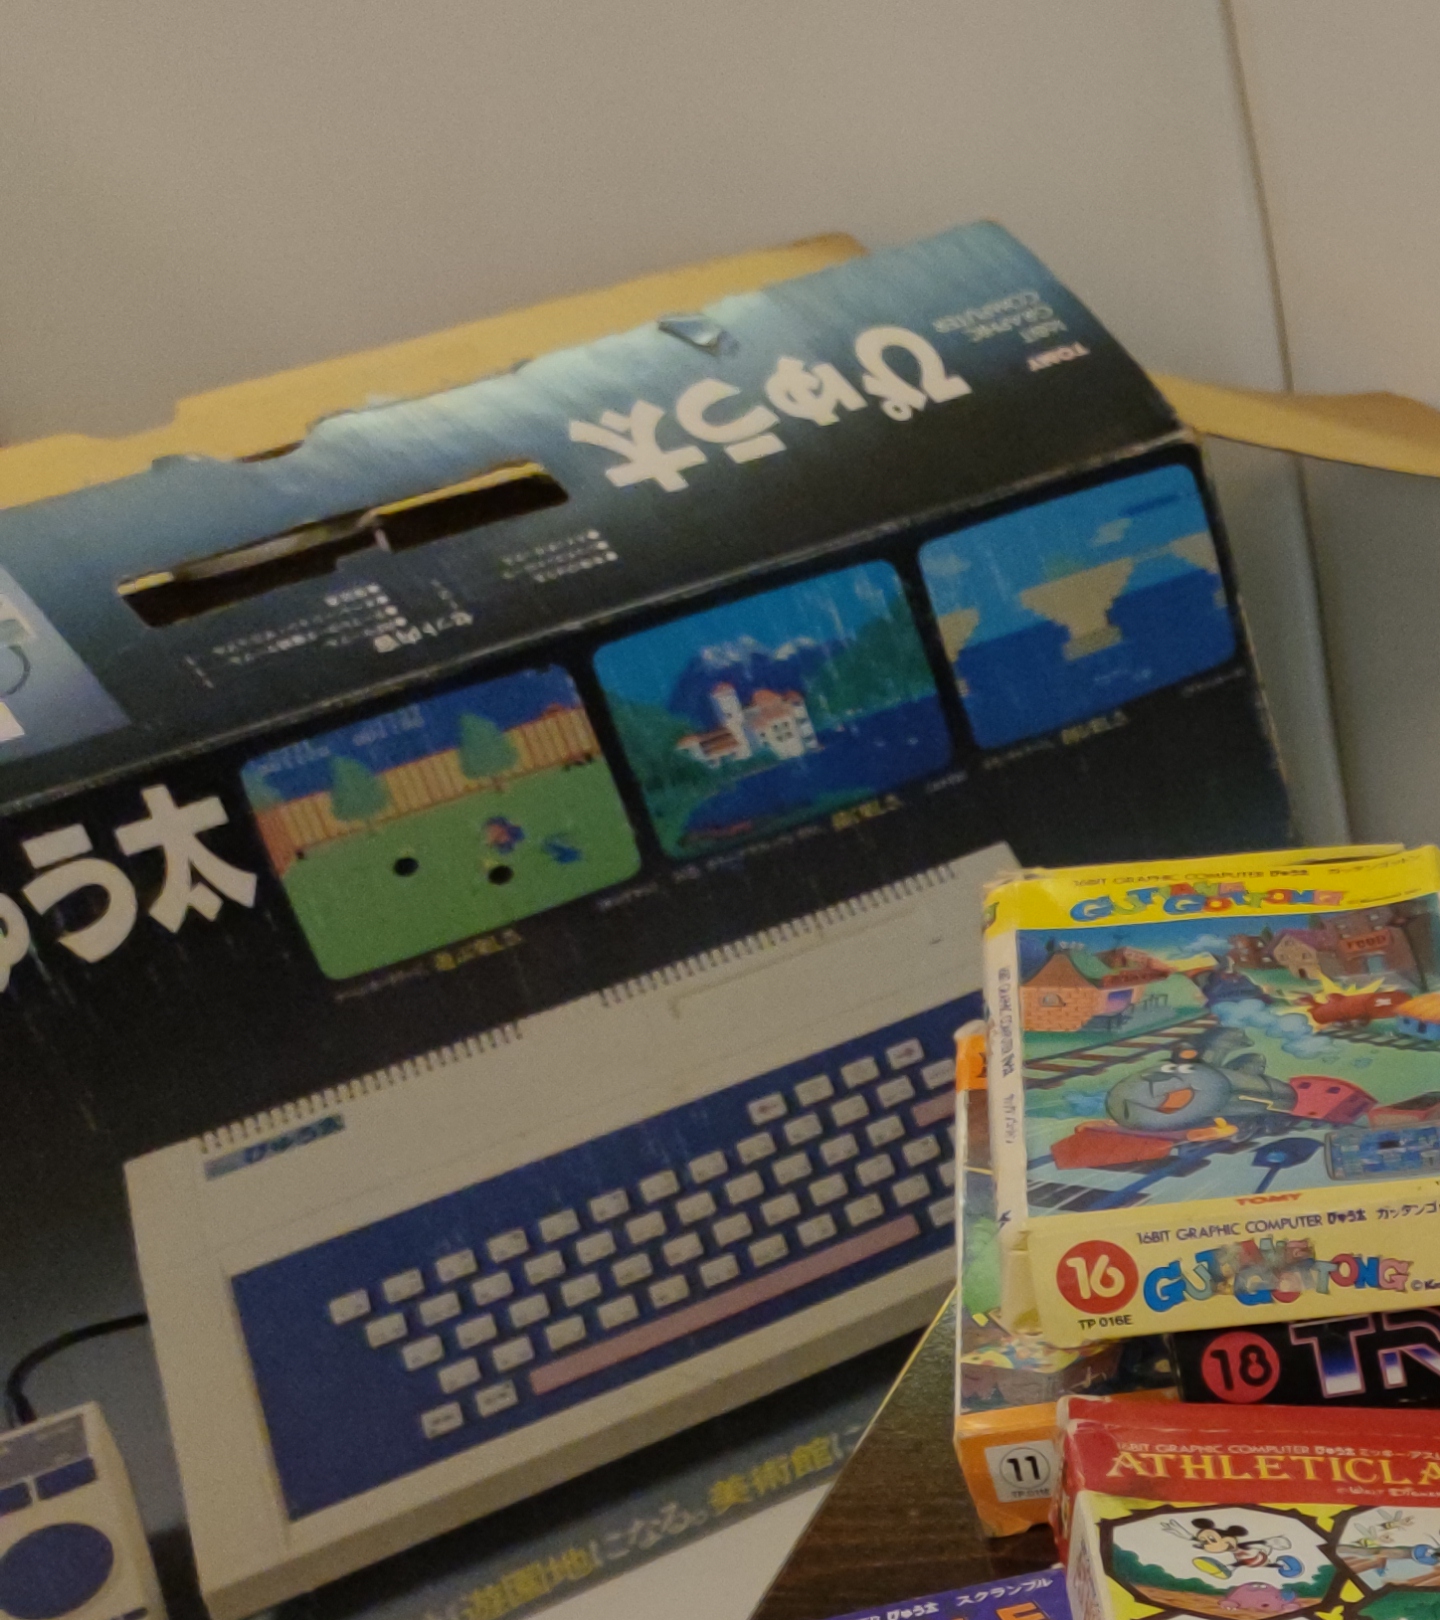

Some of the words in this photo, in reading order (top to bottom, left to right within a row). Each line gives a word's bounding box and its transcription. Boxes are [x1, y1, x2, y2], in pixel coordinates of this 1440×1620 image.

[1236, 1193, 1301, 1206] TOMY
[1136, 1230, 1171, 1244] 16BIT
[1175, 1222, 1241, 1240] GRAPHIC
[1245, 1213, 1323, 1235] COMPUTER
[1065, 1254, 1126, 1301] 16
[1078, 1317, 1098, 1331] TP
[1210, 1344, 1274, 1391] 18
[1006, 1455, 1041, 1482] 11
